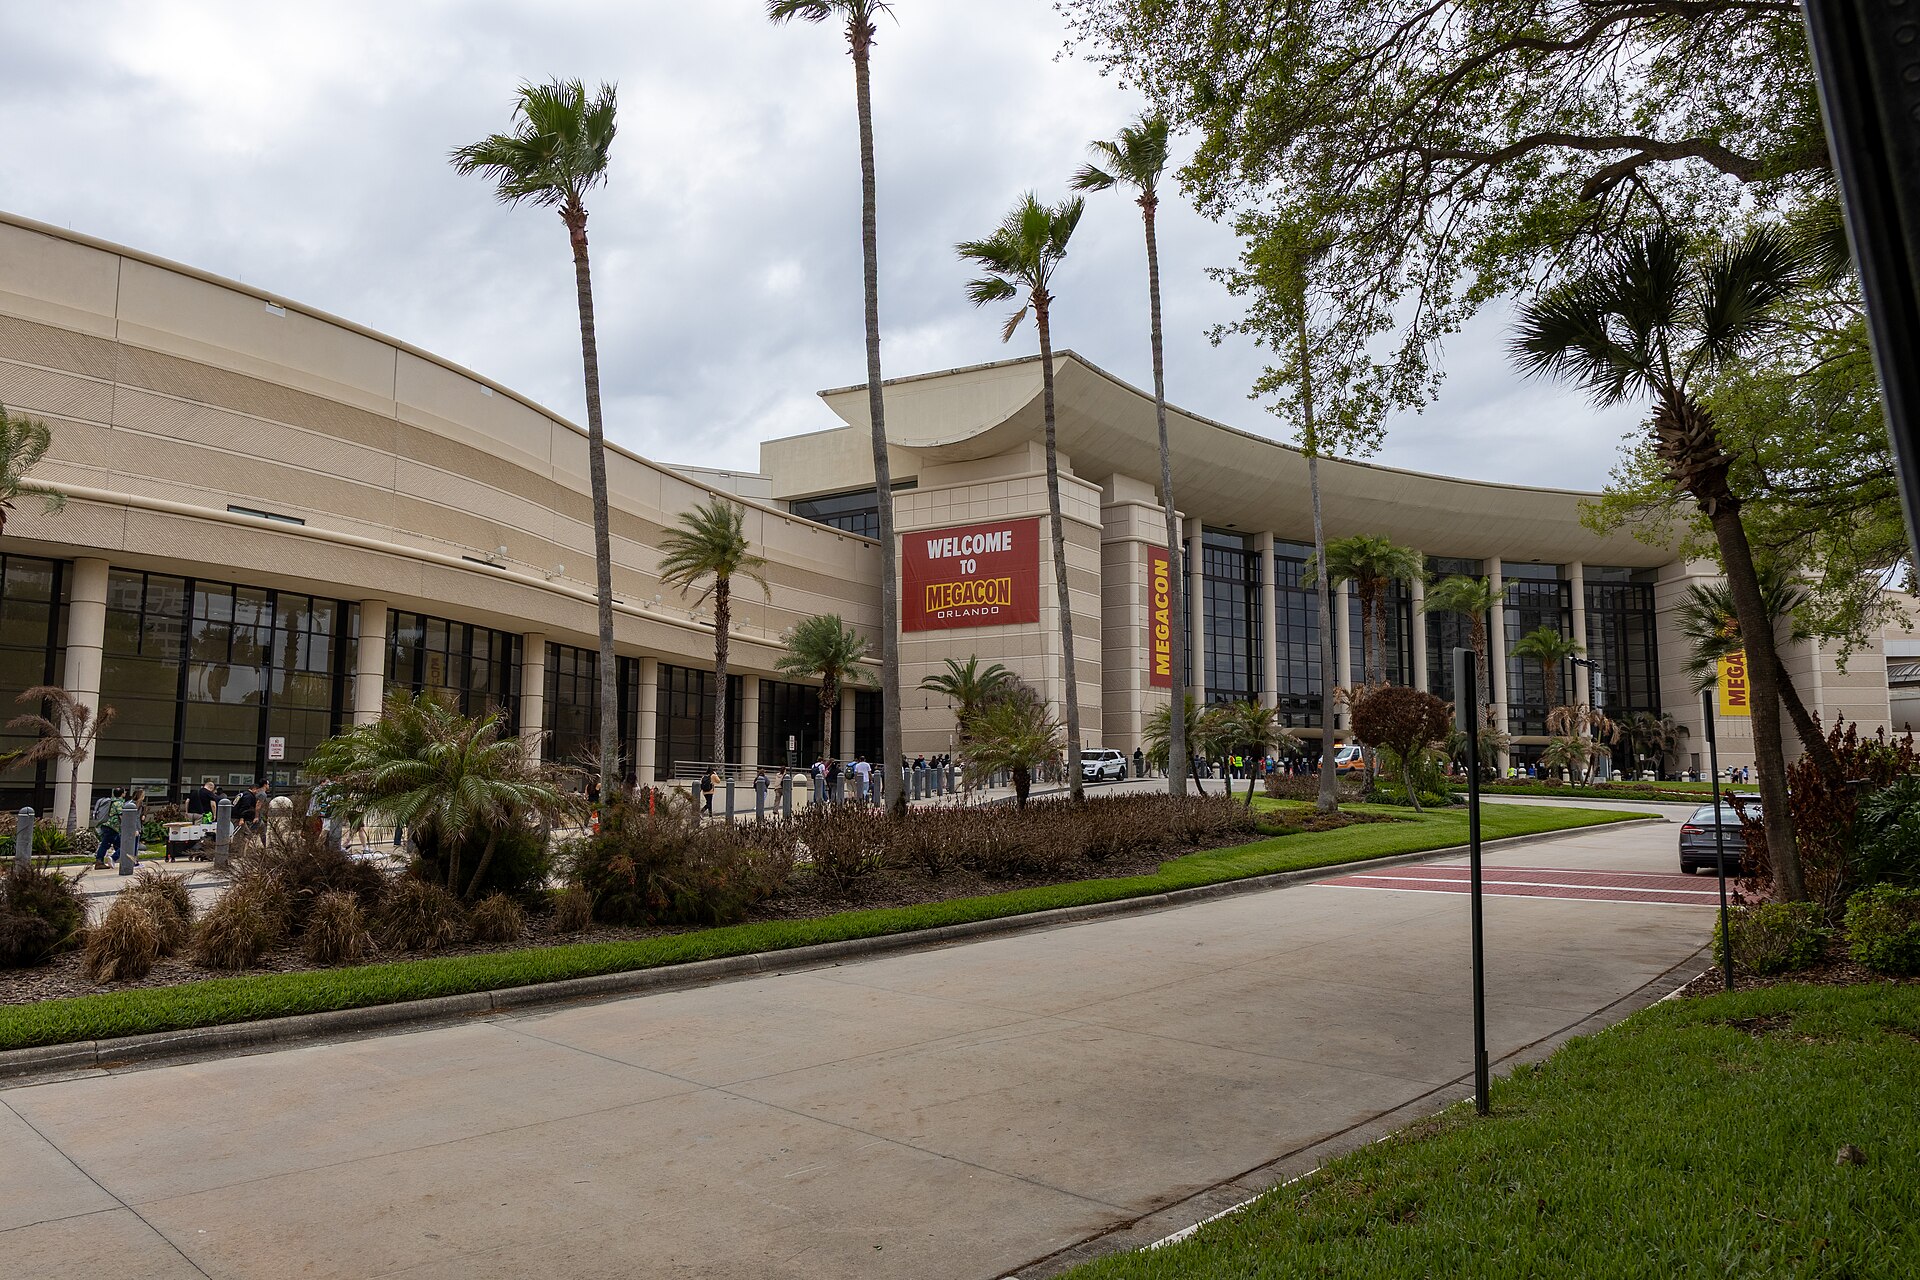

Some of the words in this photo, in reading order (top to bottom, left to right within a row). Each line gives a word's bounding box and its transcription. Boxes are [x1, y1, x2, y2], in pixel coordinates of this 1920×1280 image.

[927, 530, 1012, 559] WELCOME
[959, 558, 977, 575] TO
[926, 577, 1011, 613] MEGACON
[937, 606, 999, 619] ORLANDO
[1154, 558, 1170, 676] MEGACON
[1725, 612, 1746, 706] MEGA
